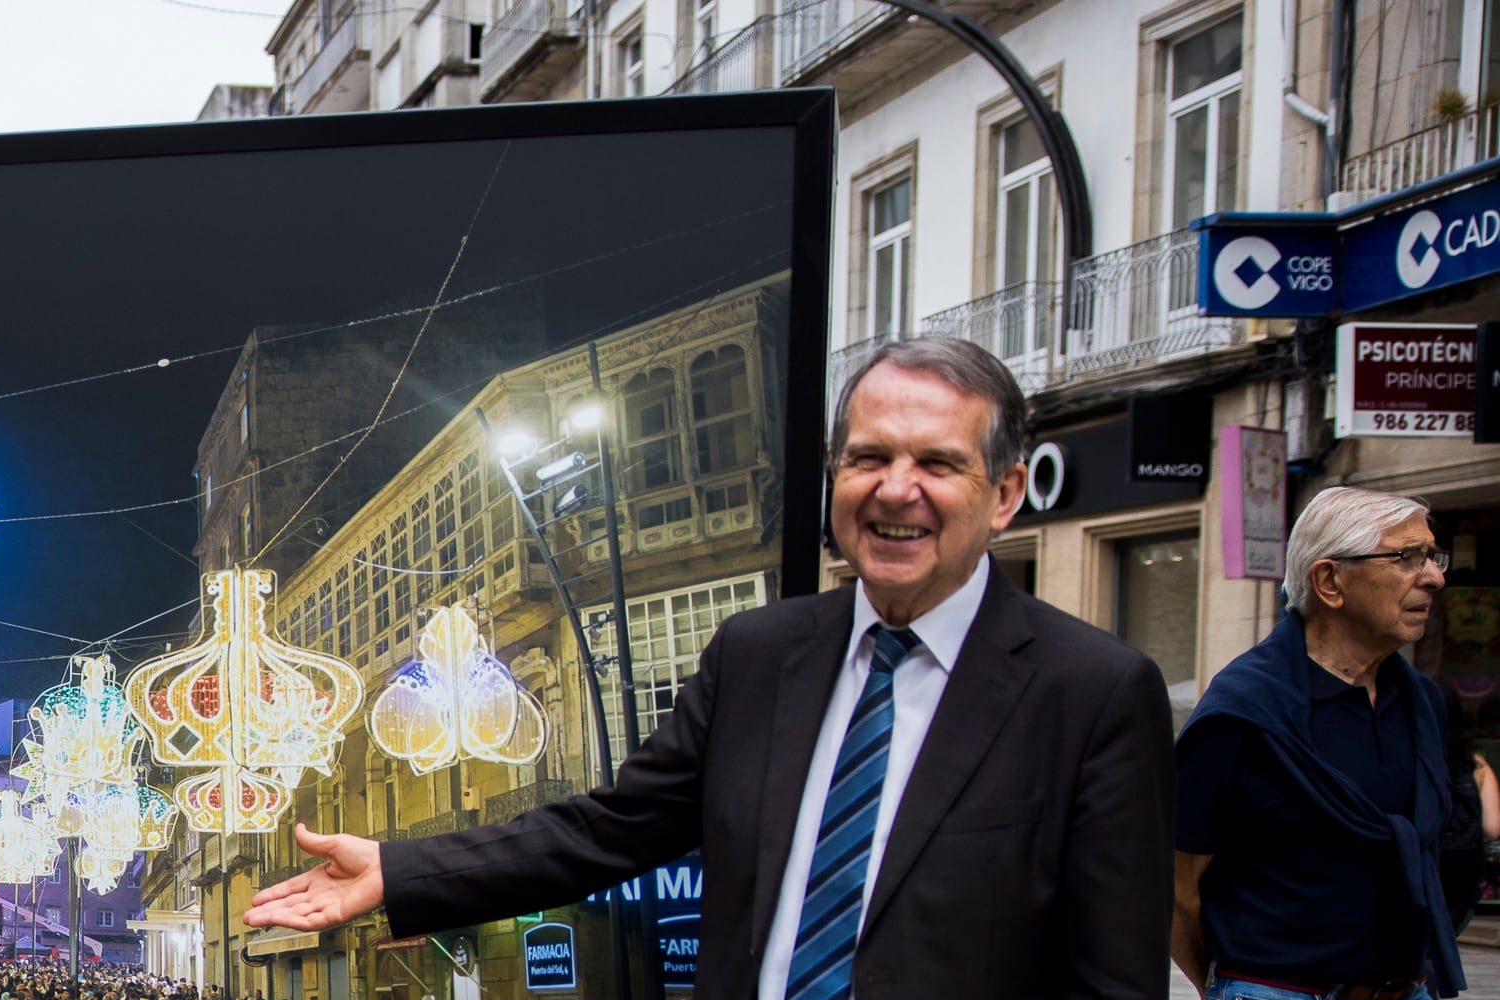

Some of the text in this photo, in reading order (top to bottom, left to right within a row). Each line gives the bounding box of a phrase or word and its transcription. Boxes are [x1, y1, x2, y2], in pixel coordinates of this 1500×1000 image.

[1287, 256, 1332, 273] COPE
[1287, 274, 1333, 291] VIGO
[1357, 335, 1477, 362] PSICOTÉCN
[1385, 368, 1477, 389] PRÍNCIPE
[1374, 413, 1408, 430] 986
[1414, 414, 1449, 431] 227
[1138, 463, 1204, 477] MANGO
[527, 943, 570, 961] FARMACIA
[531, 966, 547, 975] Puerta
[547, 965, 555, 974] del
